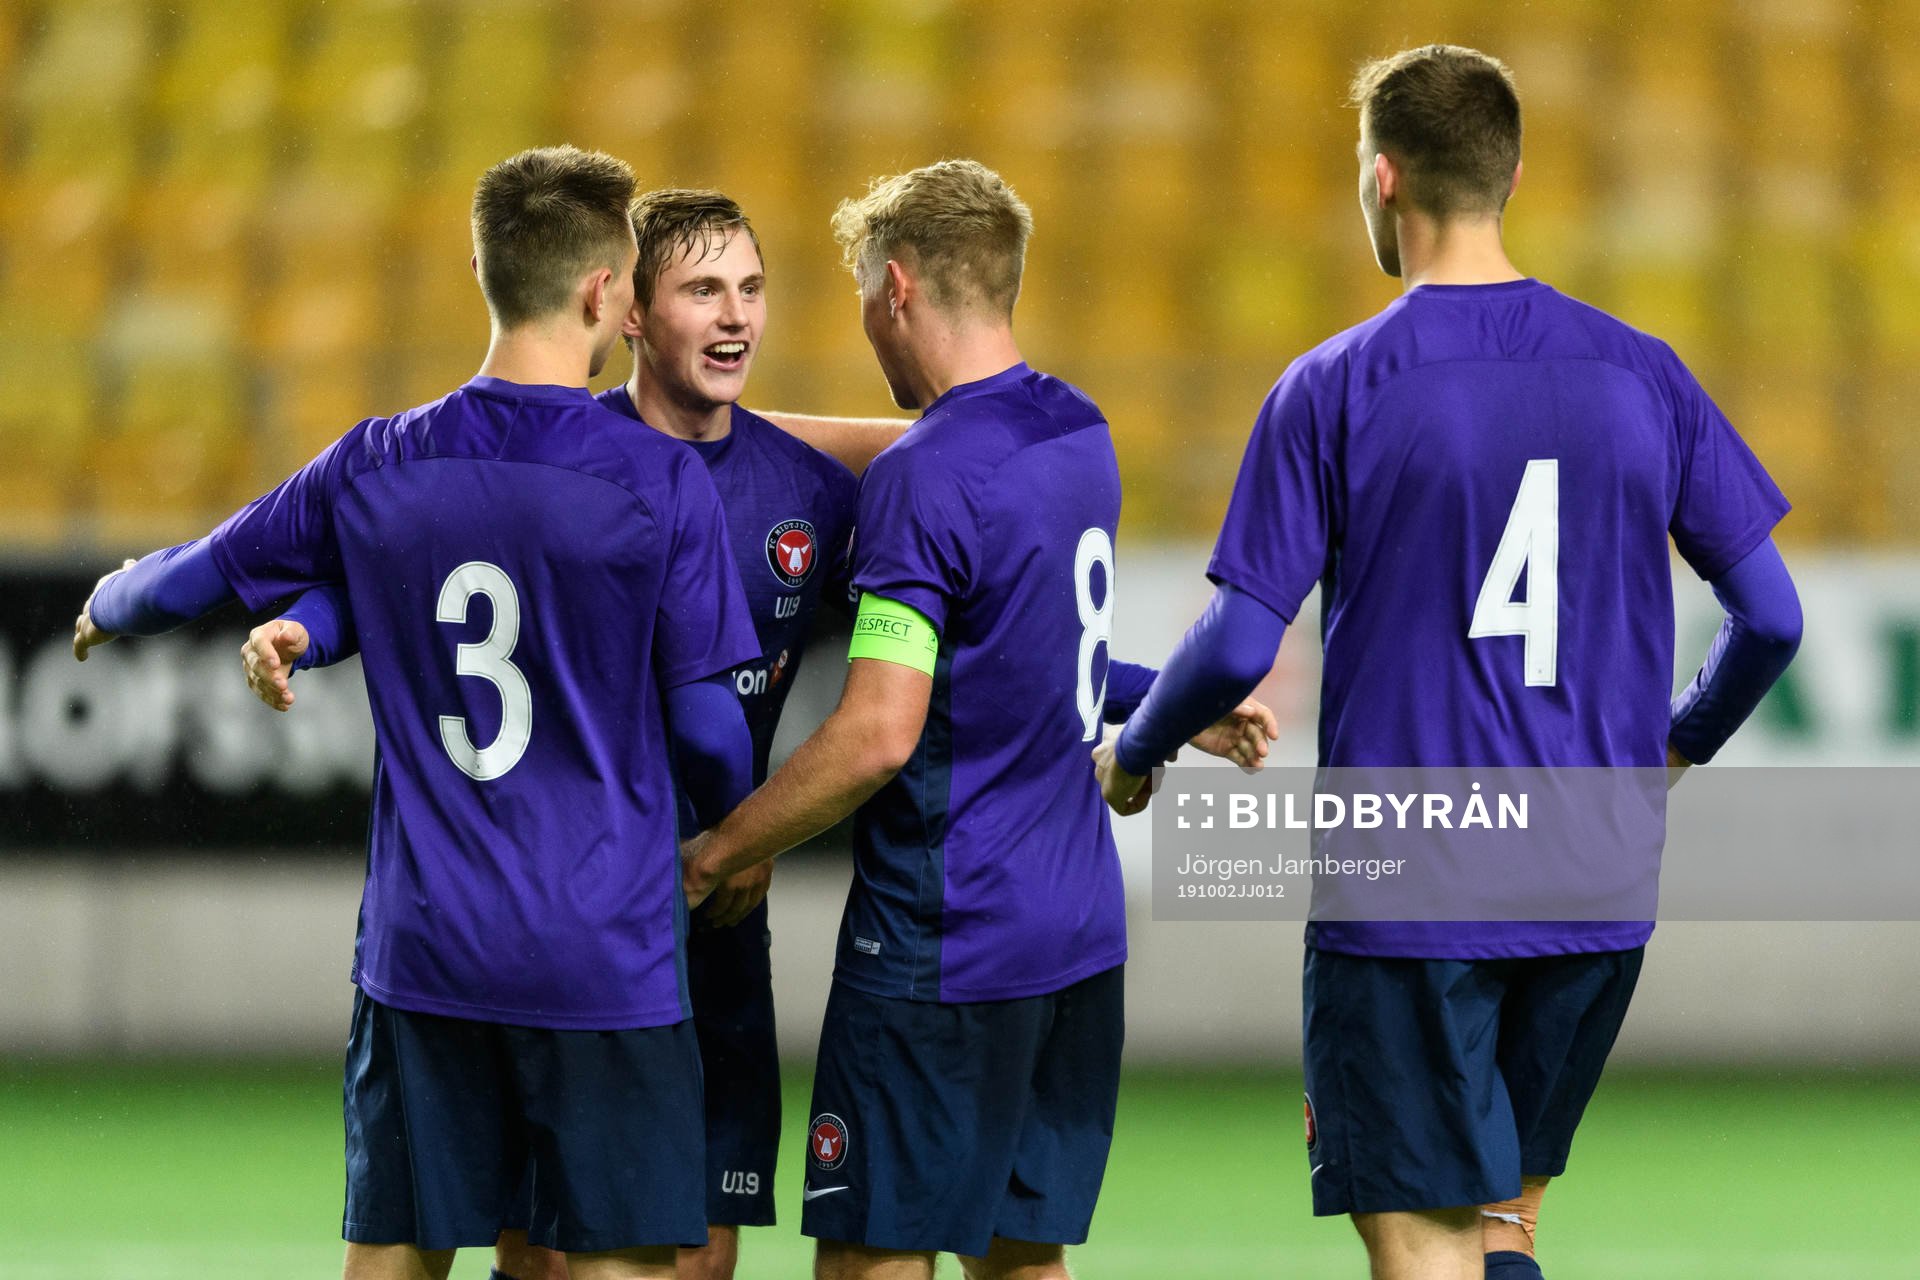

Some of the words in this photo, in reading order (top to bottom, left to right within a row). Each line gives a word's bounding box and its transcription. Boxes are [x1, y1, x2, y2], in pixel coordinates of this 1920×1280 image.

[1468, 459, 1558, 687] 4
[775, 595, 800, 618] U19
[856, 618, 912, 636] RESPECT
[1074, 527, 1114, 741] 8
[436, 561, 532, 781] 3
[732, 669, 768, 695] on
[721, 1170, 759, 1195] U19
